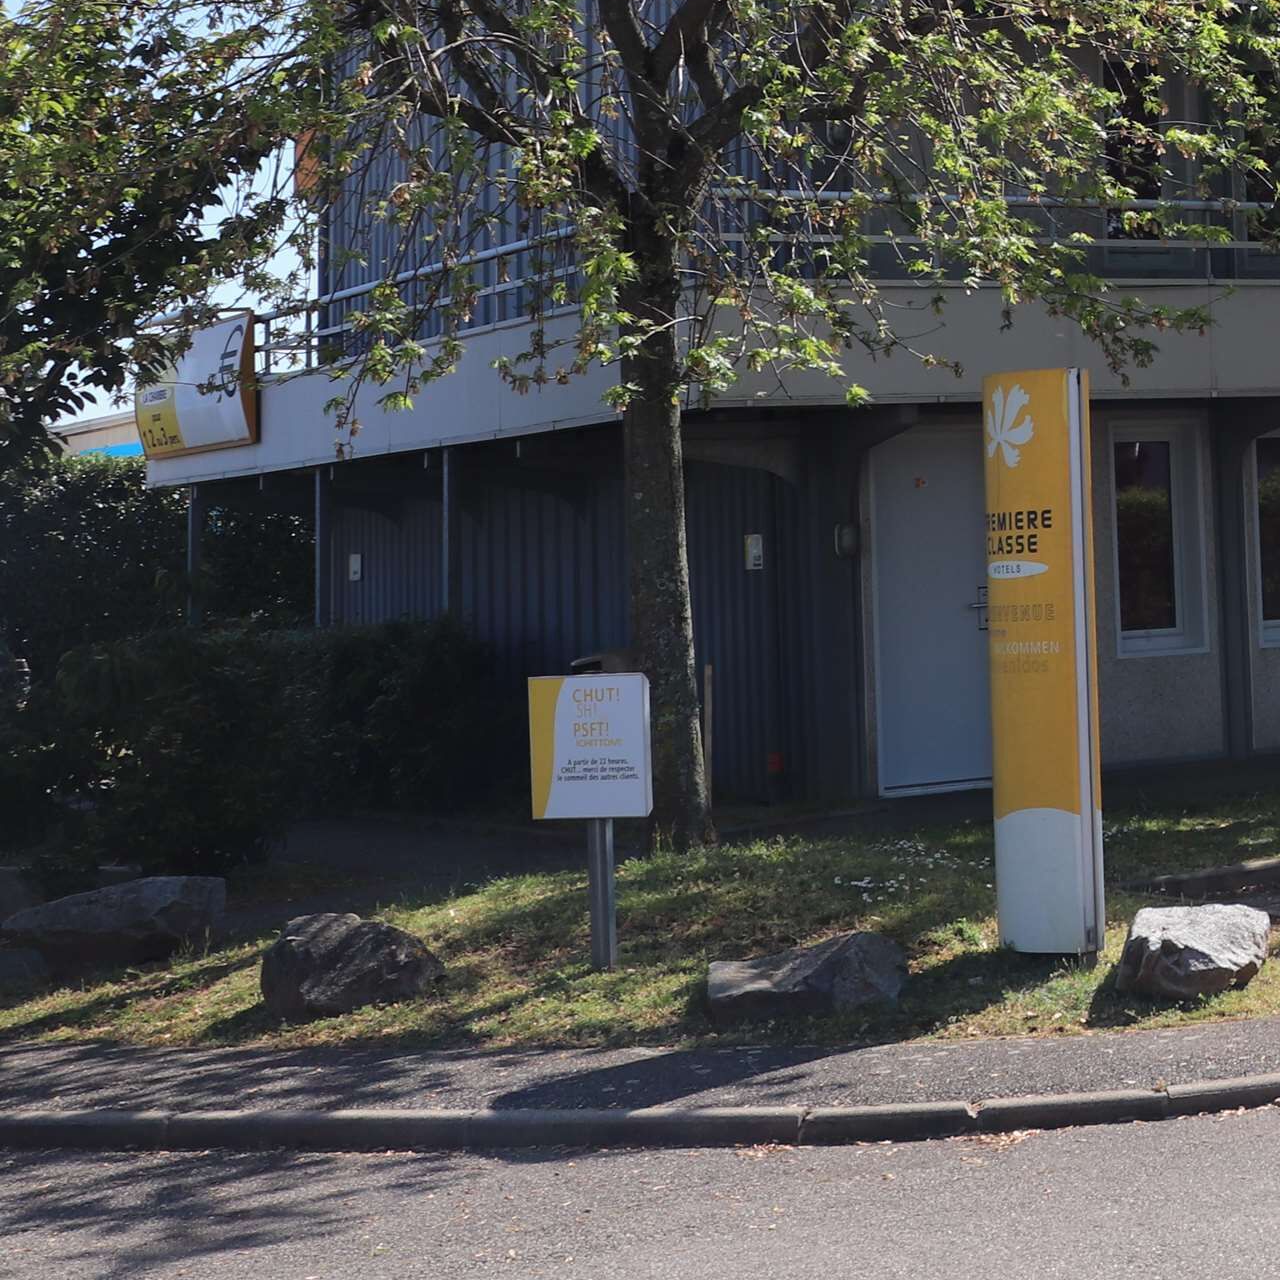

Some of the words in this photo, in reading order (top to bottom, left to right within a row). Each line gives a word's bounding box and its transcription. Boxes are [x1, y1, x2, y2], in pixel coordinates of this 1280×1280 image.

[985, 509, 1052, 530] REMIERE
[988, 534, 1037, 555] CLASSE
[572, 687, 620, 702] CHUT!
